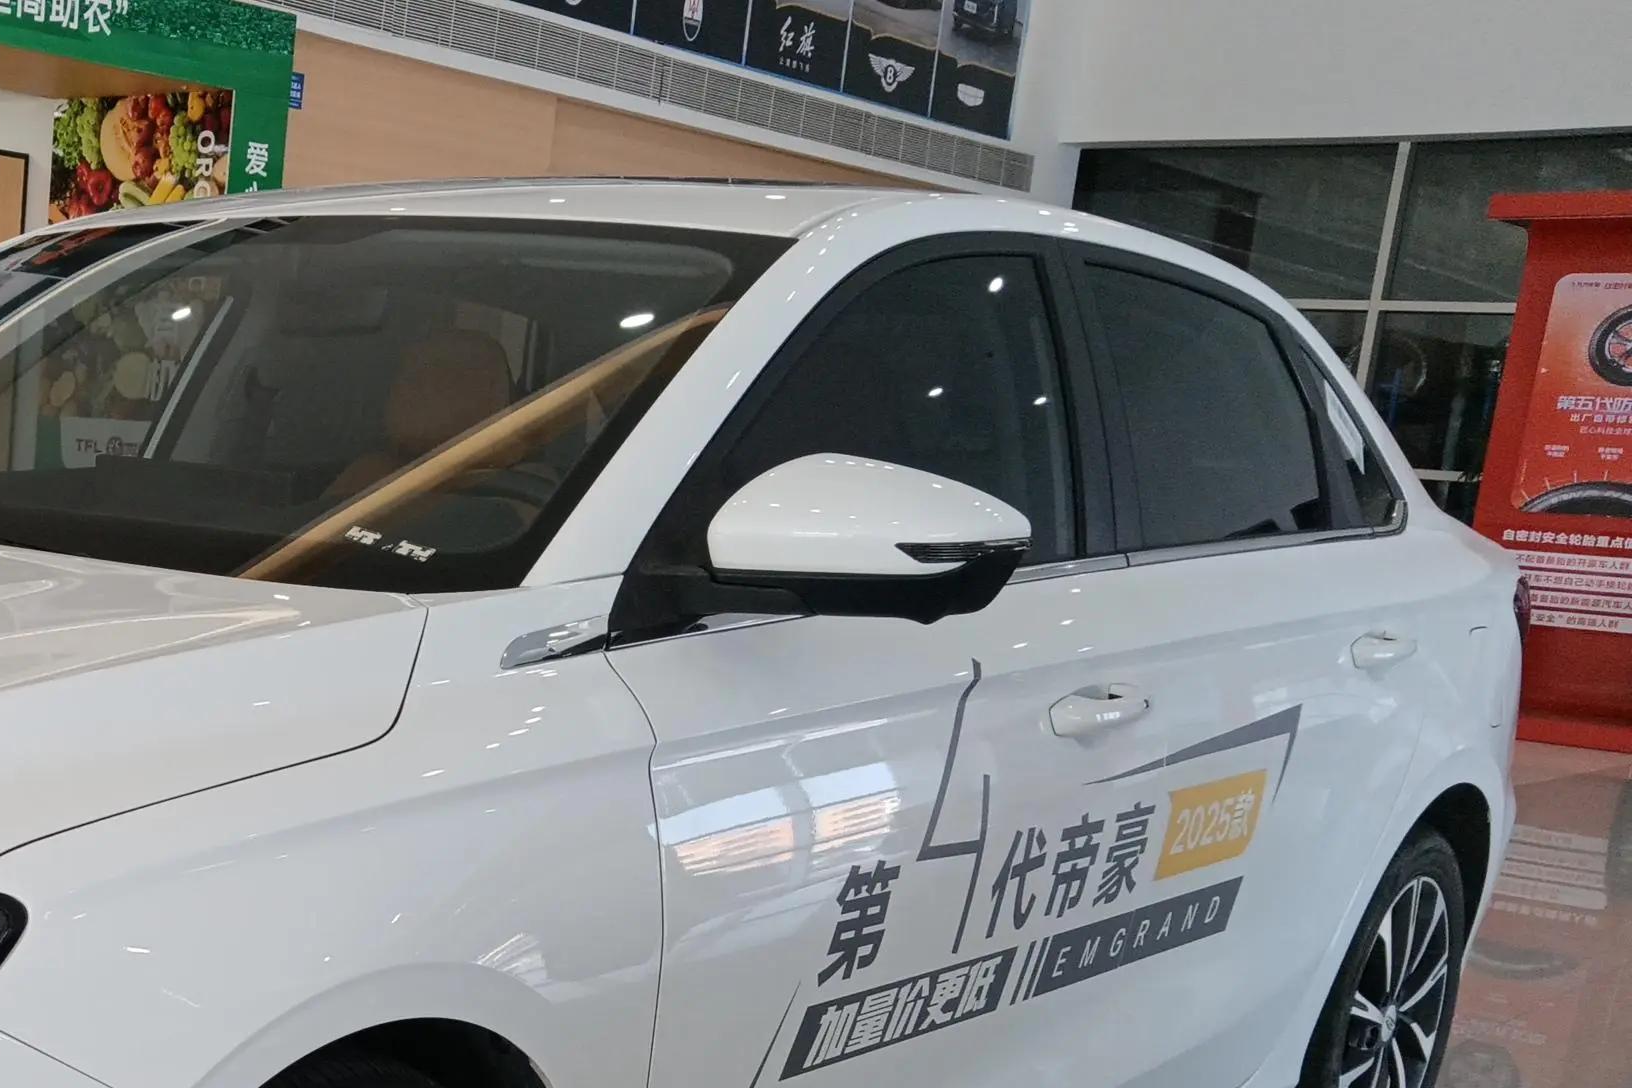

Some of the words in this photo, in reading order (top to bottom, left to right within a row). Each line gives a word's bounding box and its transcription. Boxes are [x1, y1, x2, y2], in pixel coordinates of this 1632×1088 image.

[778, 16, 816, 58] 红旗
[1169, 788, 1256, 857] 2025款
[1051, 895, 1221, 978] EMGRAND
[802, 954, 1003, 1069] 加量价更低
